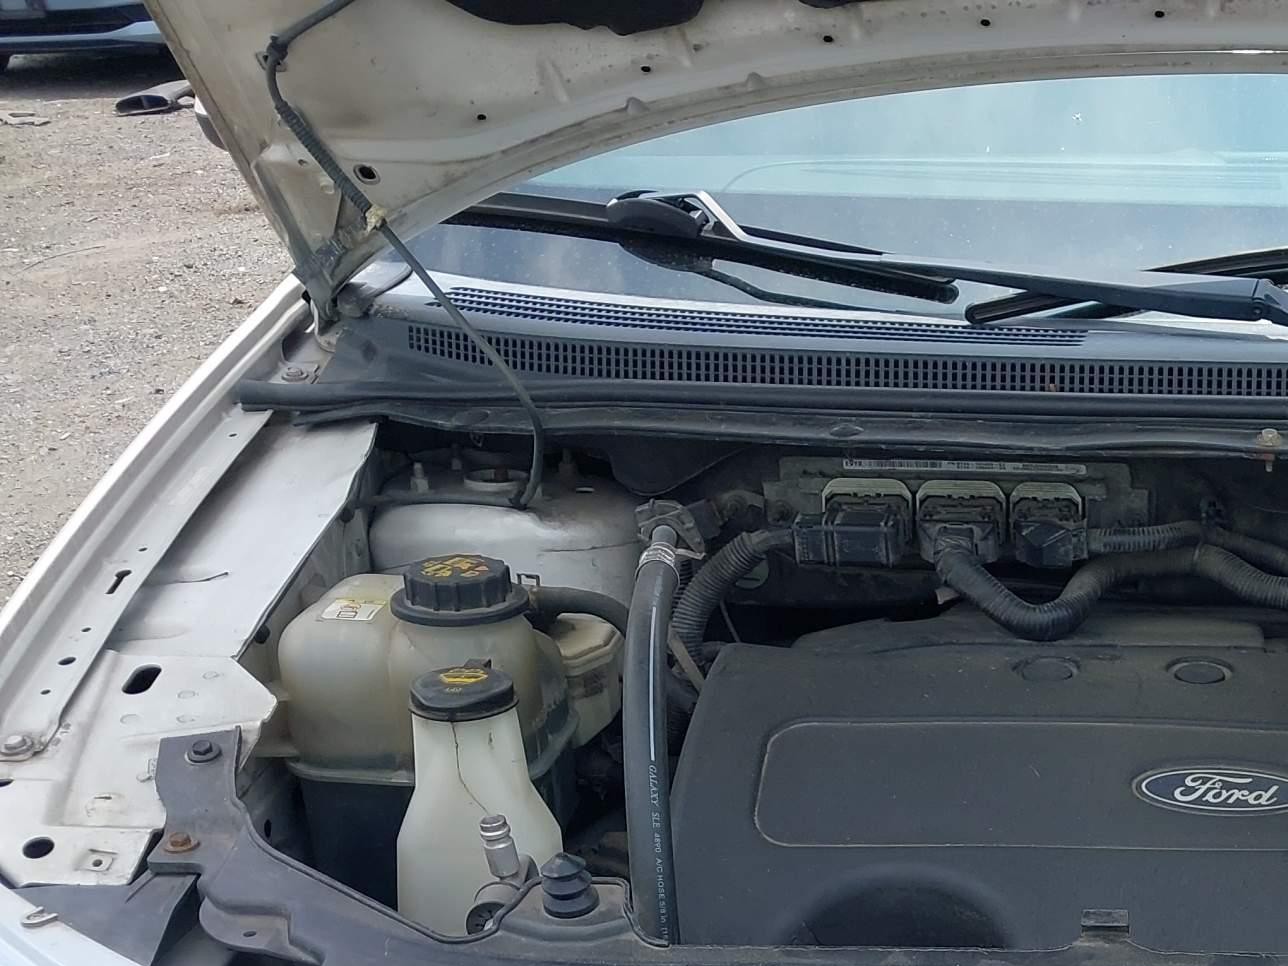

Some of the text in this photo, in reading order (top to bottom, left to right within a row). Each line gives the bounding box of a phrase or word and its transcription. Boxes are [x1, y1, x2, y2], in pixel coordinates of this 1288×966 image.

[648, 764, 658, 807] GALAXY
[1174, 773, 1280, 805] Ford
[651, 811, 661, 829] SLE
[655, 857, 664, 873] A/C
[656, 875, 666, 899] HOSE
